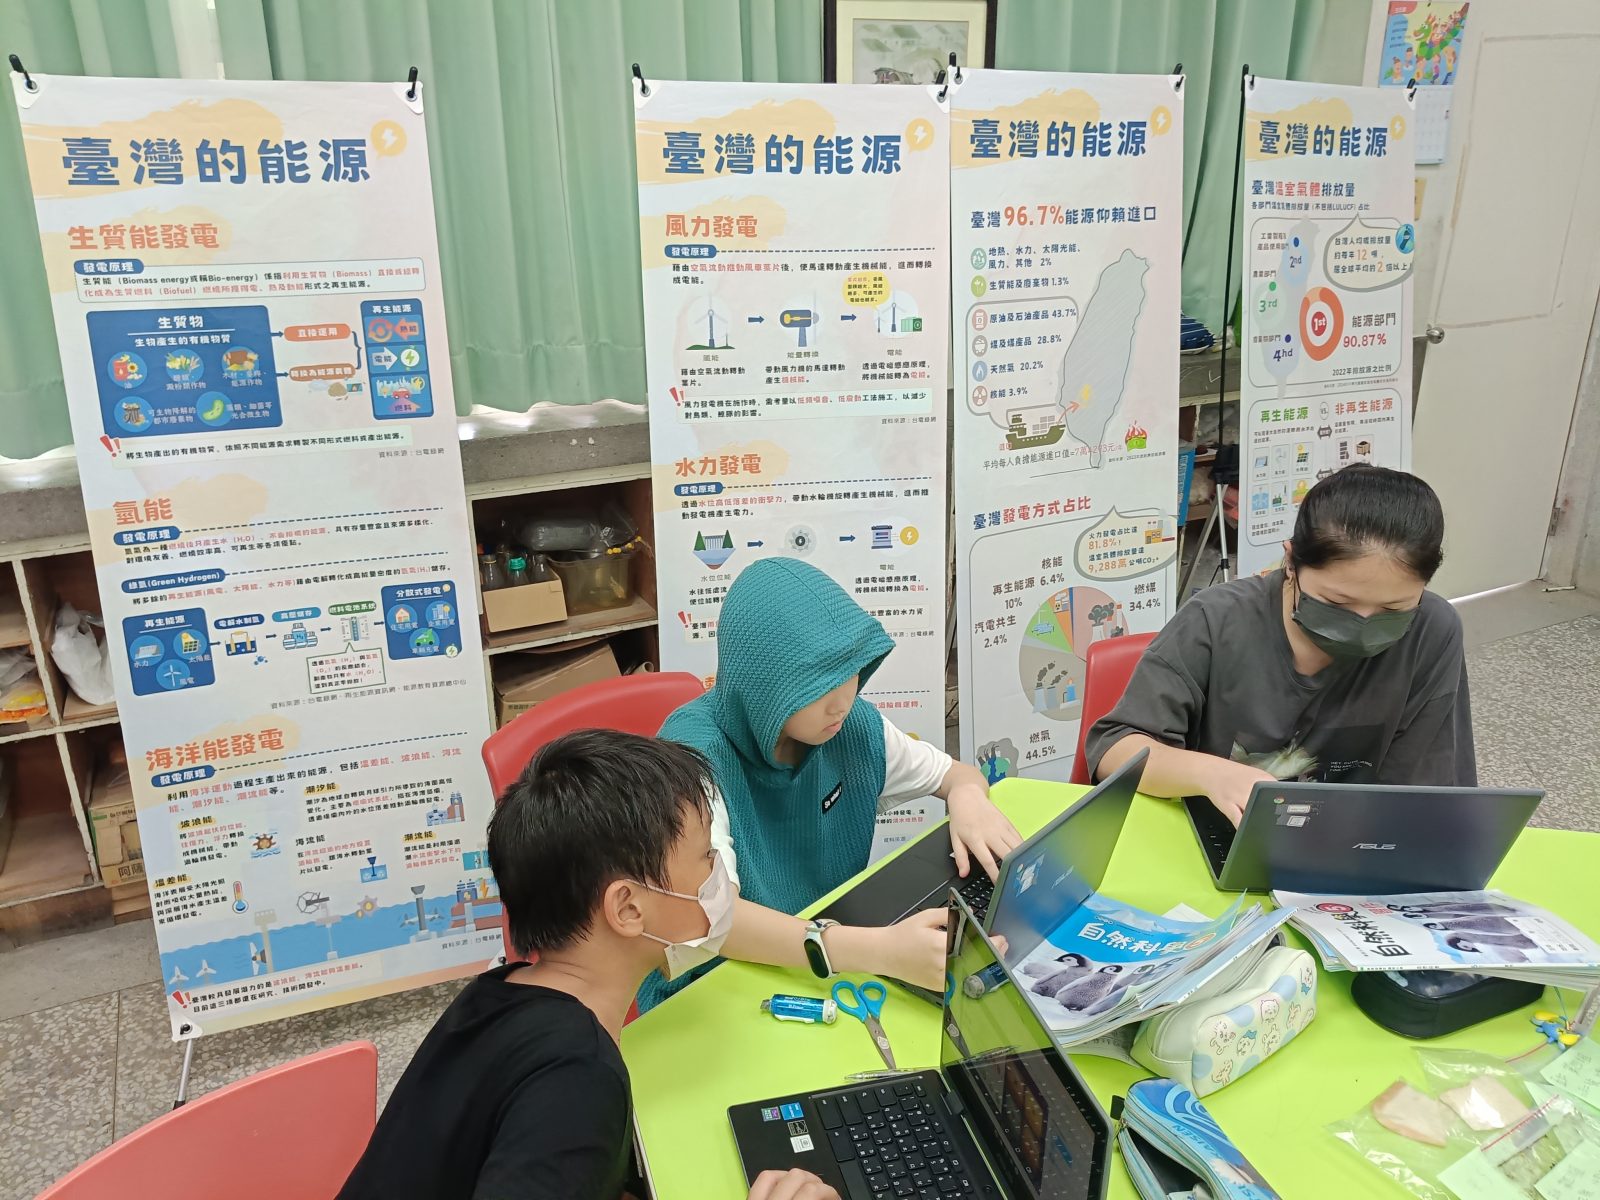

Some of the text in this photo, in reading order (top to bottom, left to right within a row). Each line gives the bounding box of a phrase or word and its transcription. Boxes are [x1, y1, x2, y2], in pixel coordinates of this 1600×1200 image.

[970, 118, 1147, 159] 臺灣的能源
[1259, 120, 1388, 157] 臺灣的能源
[662, 131, 902, 175] 臺灣的能源
[62, 137, 371, 186] 臺灣的能源
[1251, 180, 1355, 198] 臺灣溫室氣體排放量
[665, 214, 758, 238] 風力發電
[67, 223, 220, 251] 生質能發電
[671, 246, 709, 257] 發電原理
[83, 261, 135, 273] 發電原理
[1040, 258, 1052, 267] 2%
[1289, 255, 1302, 268] 2nd
[1051, 277, 1069, 286] 1.3%
[372, 304, 412, 314] 再生能源
[1051, 308, 1077, 318] 43.7%
[1259, 299, 1278, 313] 3rd
[157, 315, 204, 329] 生質物
[1313, 317, 1327, 332] 1st
[1351, 312, 1396, 328] 能源部門
[1037, 334, 1062, 345] 28.8%
[1342, 332, 1387, 349] 90.87%
[990, 360, 1044, 374] 天然氣 20.2%
[990, 386, 1028, 399] 核能 3.9%
[1335, 397, 1393, 416] 非再生能源
[1260, 406, 1309, 424] 再生能源
[675, 454, 762, 478] 水力發電
[680, 484, 717, 494] 發電原理
[112, 498, 174, 526] 氫能
[973, 495, 1091, 531] 臺灣發電方式占比
[122, 529, 171, 544] 發電原理
[1041, 556, 1063, 570] 核能
[177, 571, 220, 584] Hydrogen)
[992, 573, 1065, 596] 再生能源 6.4%
[396, 586, 442, 598] 分散式發電
[1134, 582, 1157, 595] 燃煤
[1005, 597, 1023, 610] 10%
[1130, 597, 1161, 612] 34.4%
[866, 607, 924, 617] 出豐富的水力資
[144, 615, 185, 628] 再生能源
[974, 616, 1017, 634] 汽電共生
[984, 634, 1008, 649] 2.4%
[1029, 731, 1051, 745] 燃氣
[145, 728, 284, 771] 海洋能發電
[1025, 745, 1056, 761] 44.5%
[159, 769, 207, 785] 發電原理
[305, 782, 337, 794] 潮汐能
[180, 816, 213, 828] 波浪能
[295, 834, 326, 847] 海流能
[404, 831, 433, 842] 潮流能
[1352, 842, 1397, 851] ASUS
[155, 873, 188, 887] 溫差能
